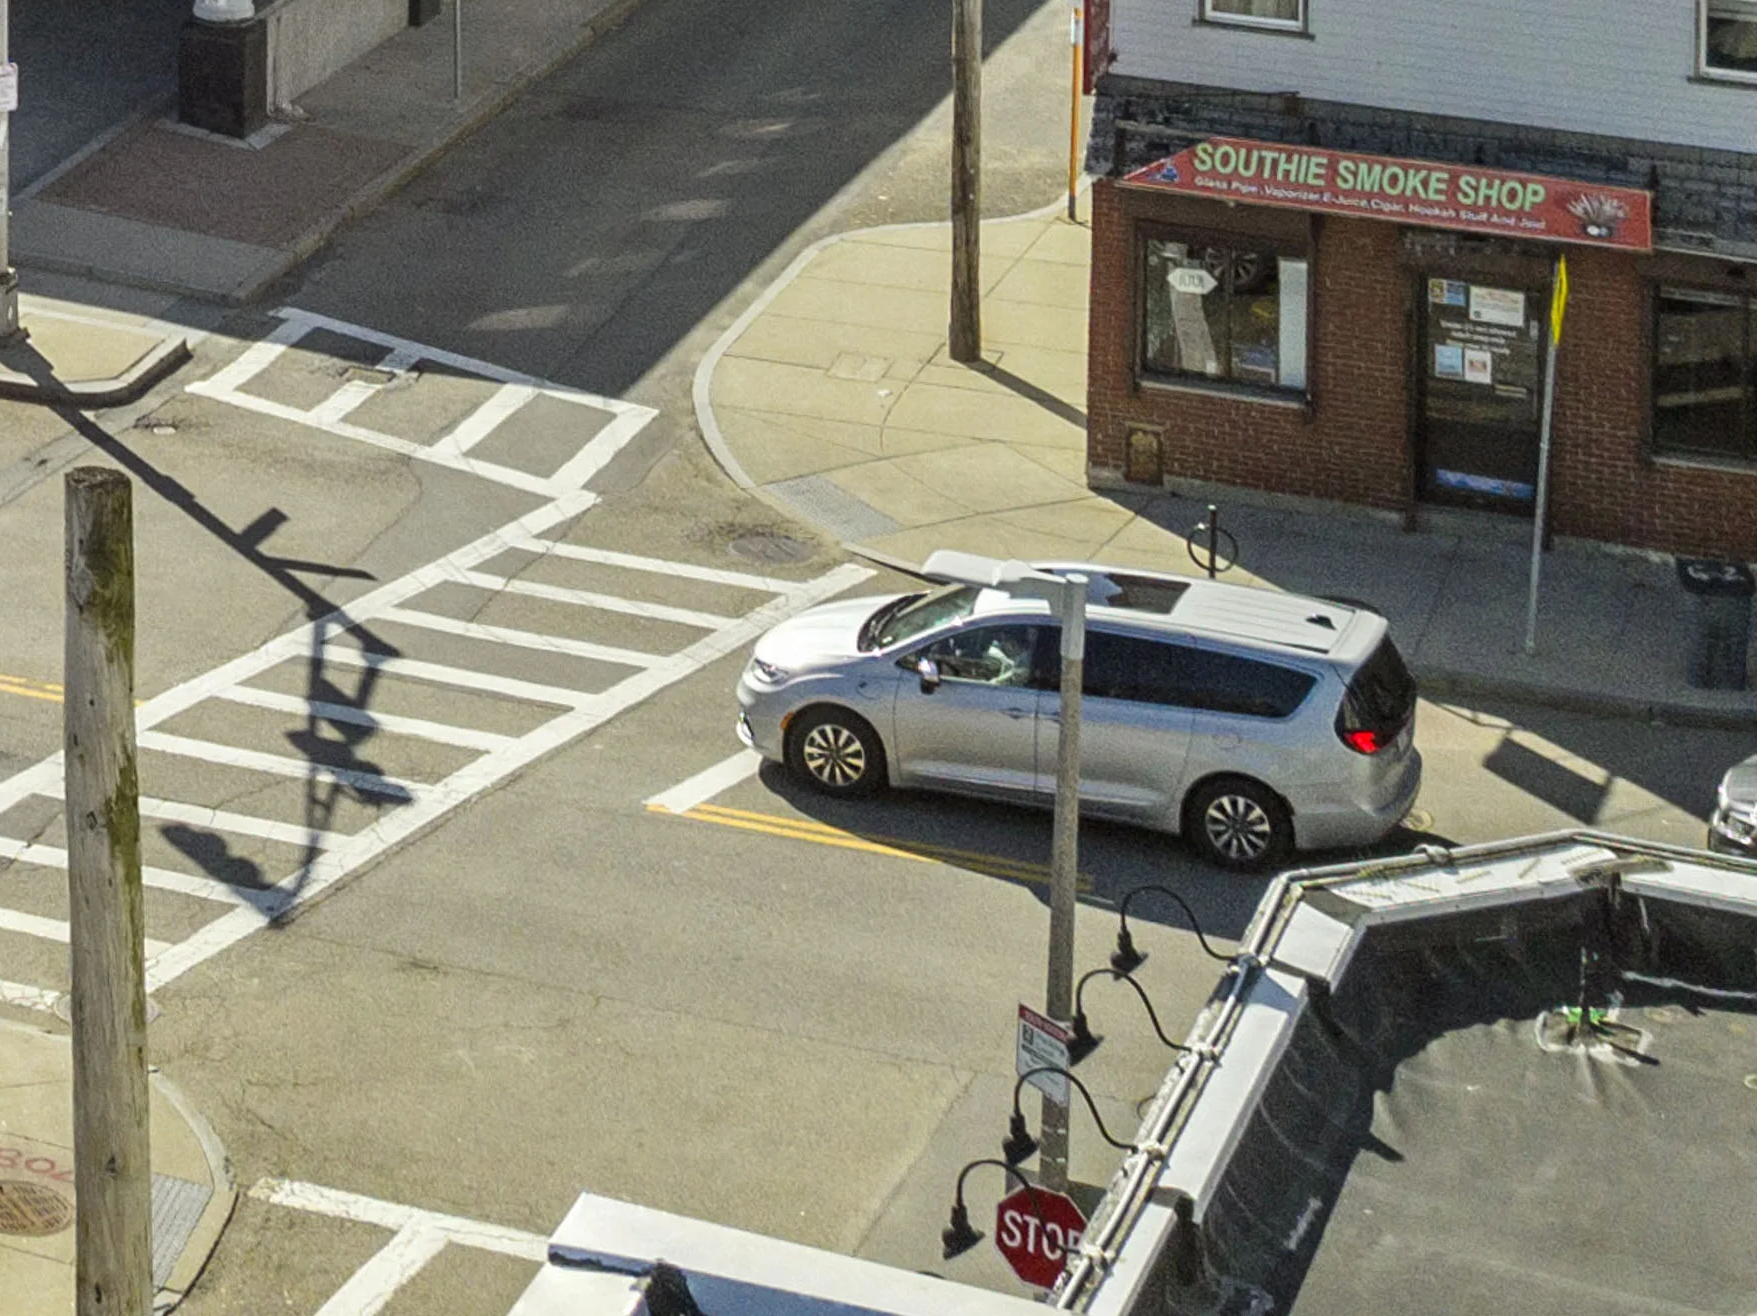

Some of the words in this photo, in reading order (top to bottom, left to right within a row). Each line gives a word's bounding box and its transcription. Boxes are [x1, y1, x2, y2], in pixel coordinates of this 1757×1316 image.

[1193, 142, 1329, 187] SOUTHIE
[1336, 159, 1450, 202] SMOKE
[1456, 175, 1547, 213] SHOP
